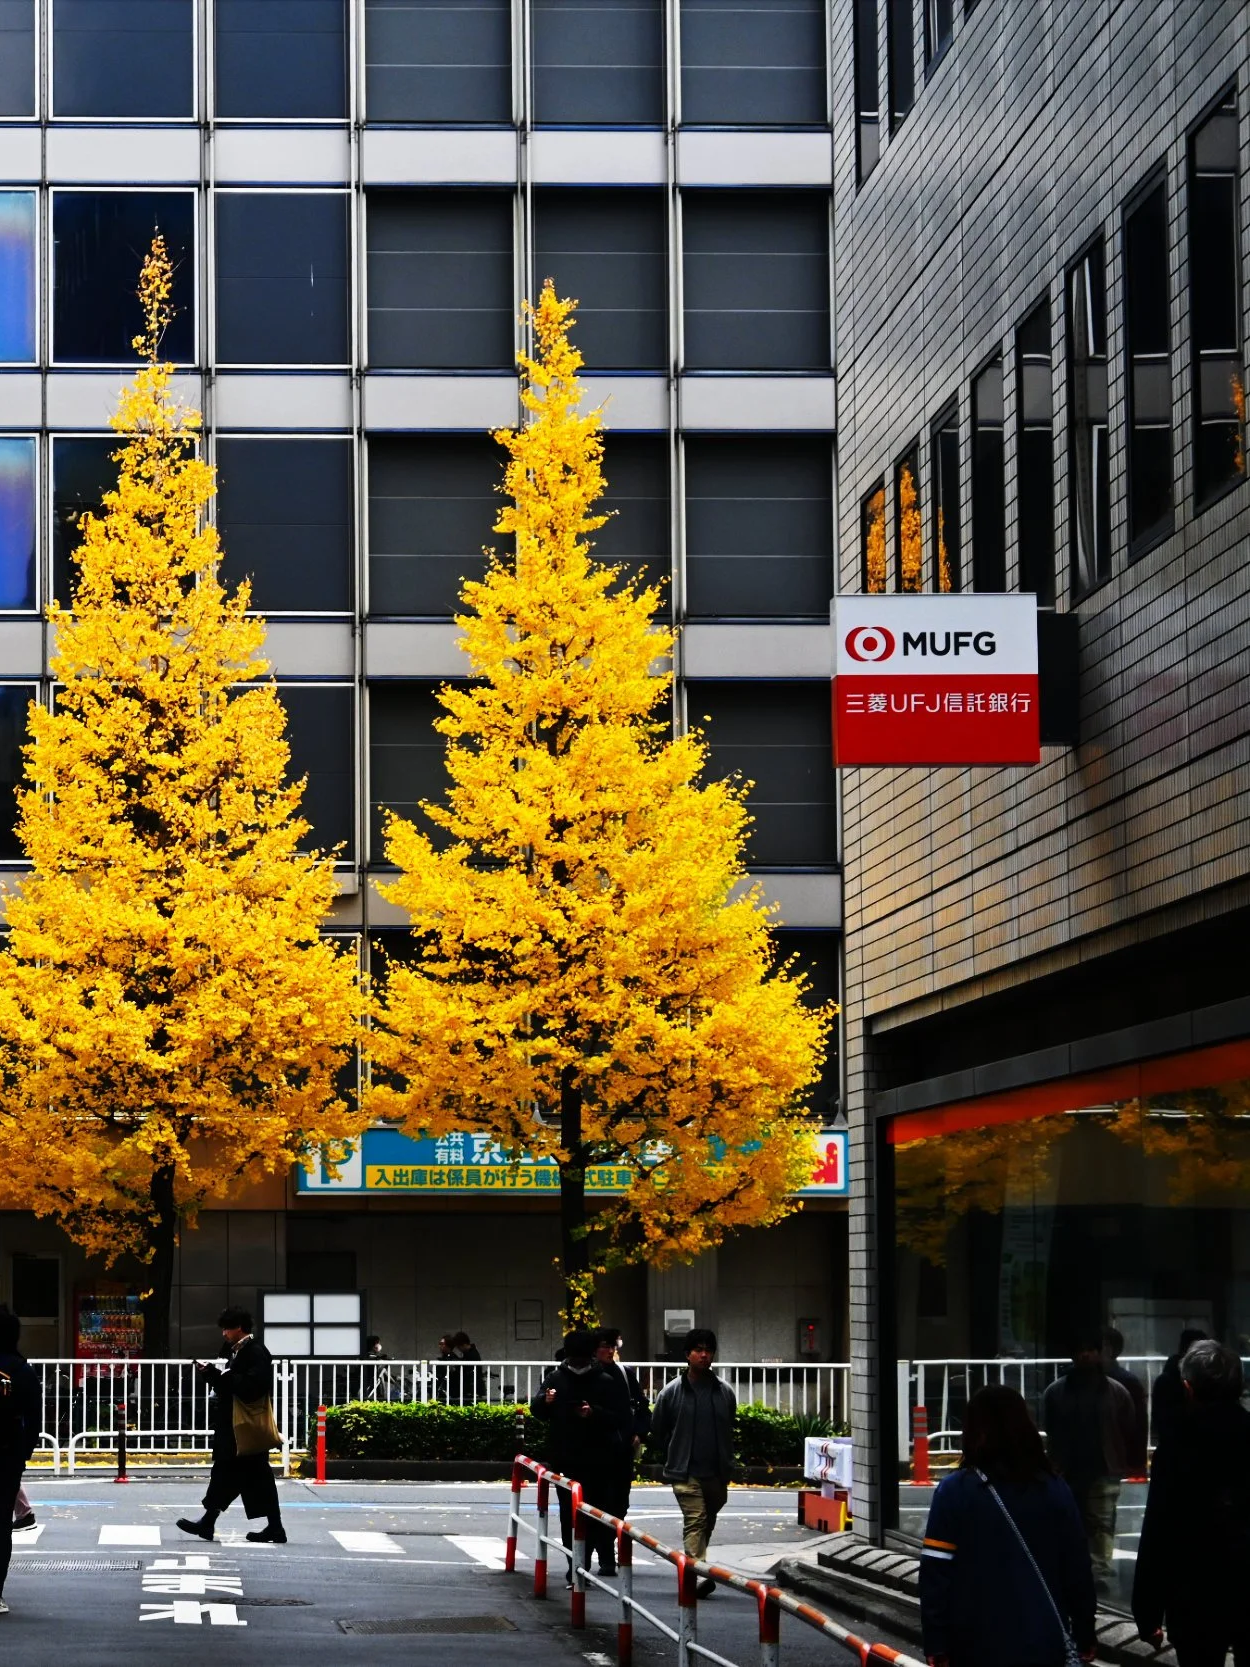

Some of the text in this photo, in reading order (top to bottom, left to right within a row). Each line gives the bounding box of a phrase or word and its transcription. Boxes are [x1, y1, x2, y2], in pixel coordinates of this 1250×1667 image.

[902, 631, 997, 657] MUFG
[845, 692, 1032, 714] 三菱UFJ信託銀行
[434, 1147, 465, 1165] 有料
[139, 1555, 248, 1626] 止まれ
